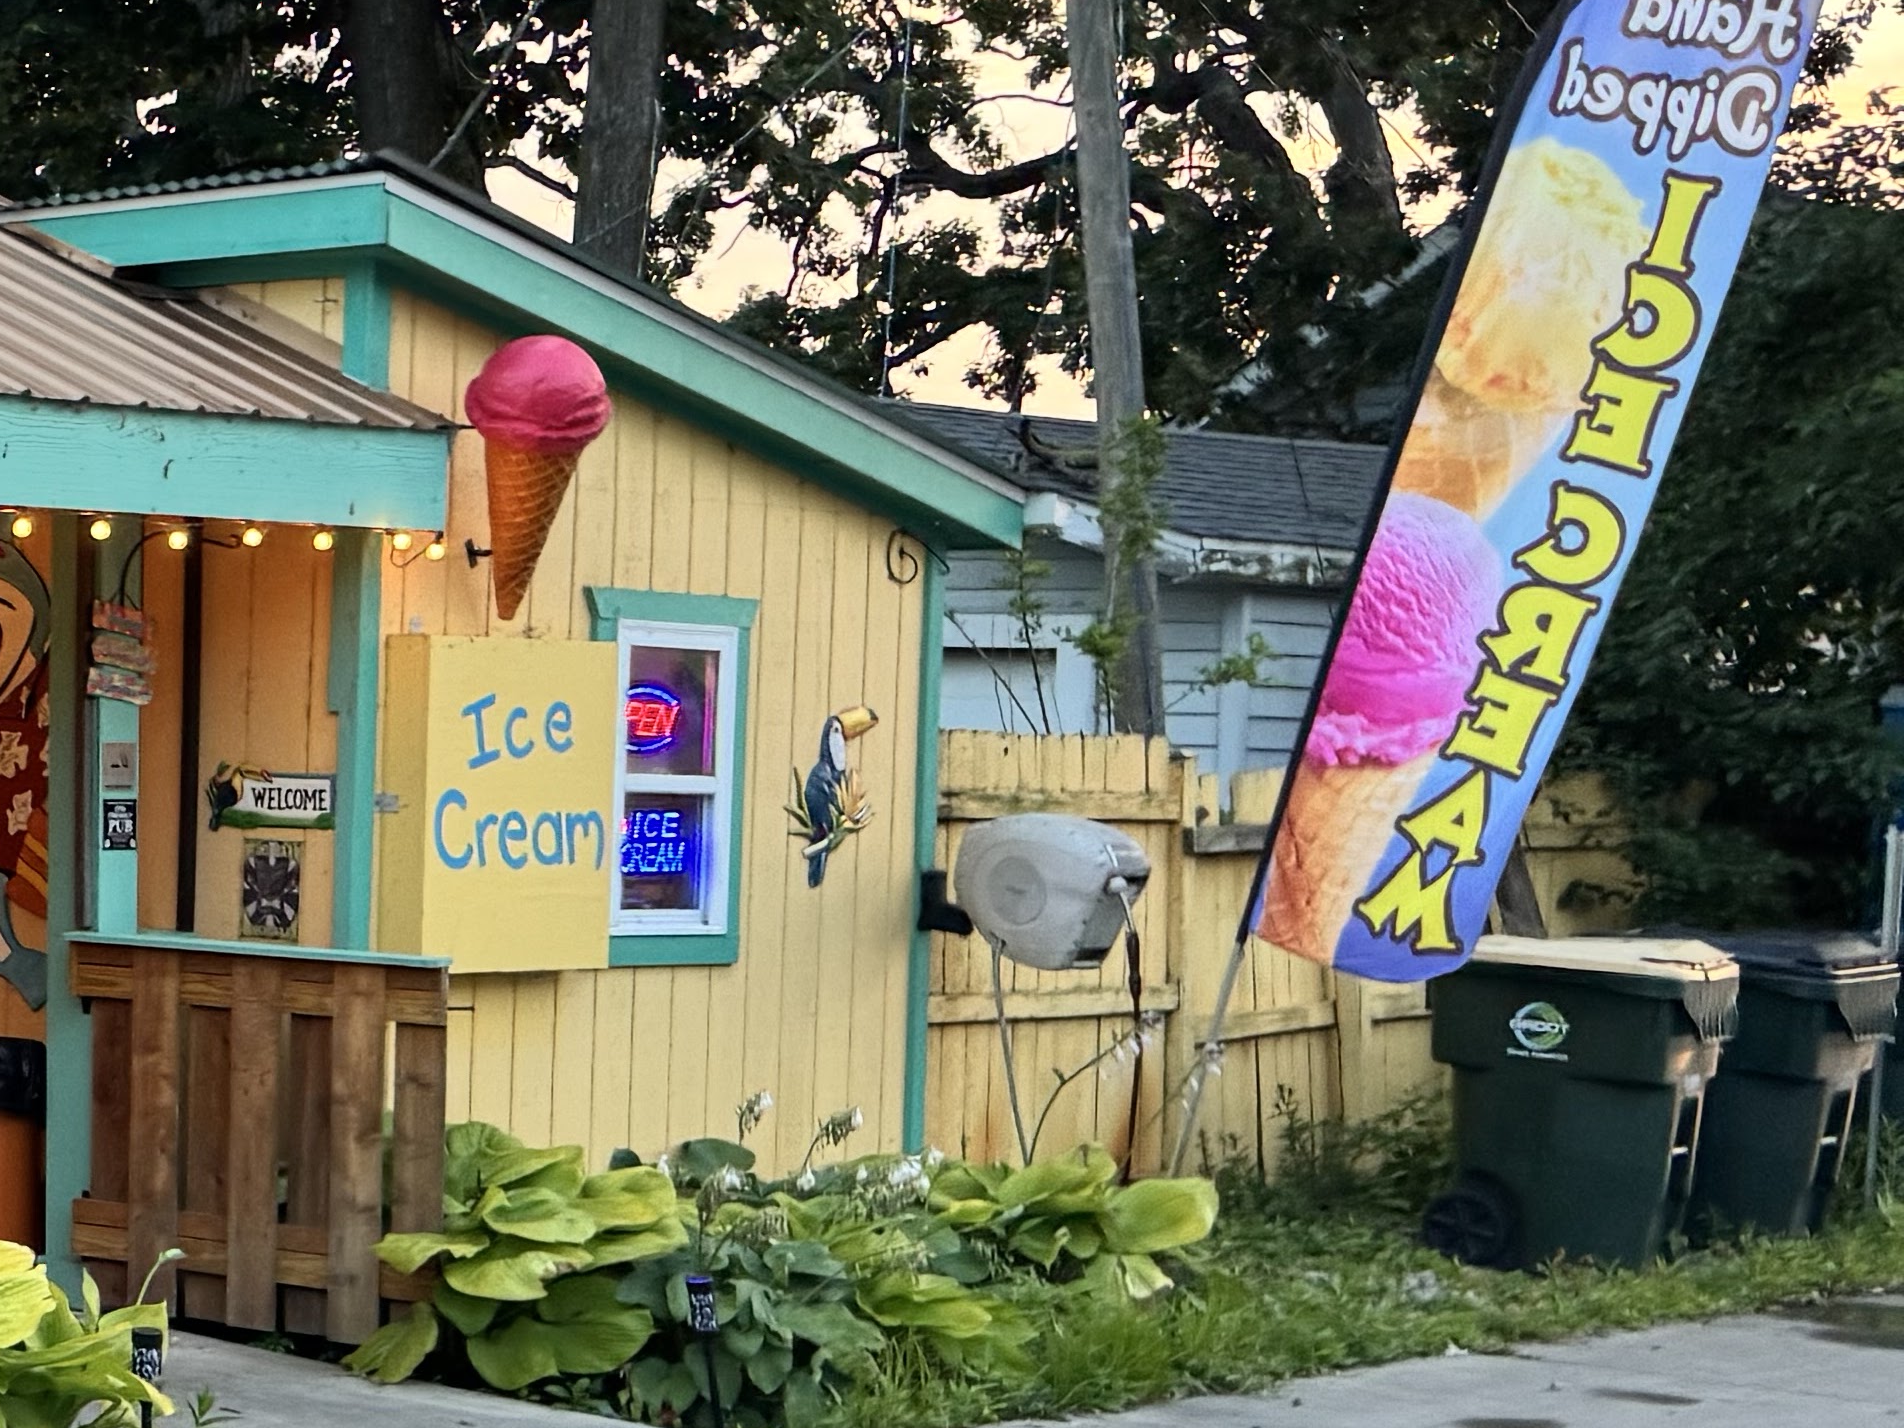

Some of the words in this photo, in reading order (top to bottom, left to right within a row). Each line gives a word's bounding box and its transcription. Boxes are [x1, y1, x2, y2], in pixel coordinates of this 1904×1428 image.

[460, 693, 574, 770] Ice
[624, 701, 681, 737] PEN
[251, 787, 328, 811] WELCOME
[108, 819, 134, 834] PUB
[434, 788, 605, 871] Cream
[633, 811, 680, 839] ICE
